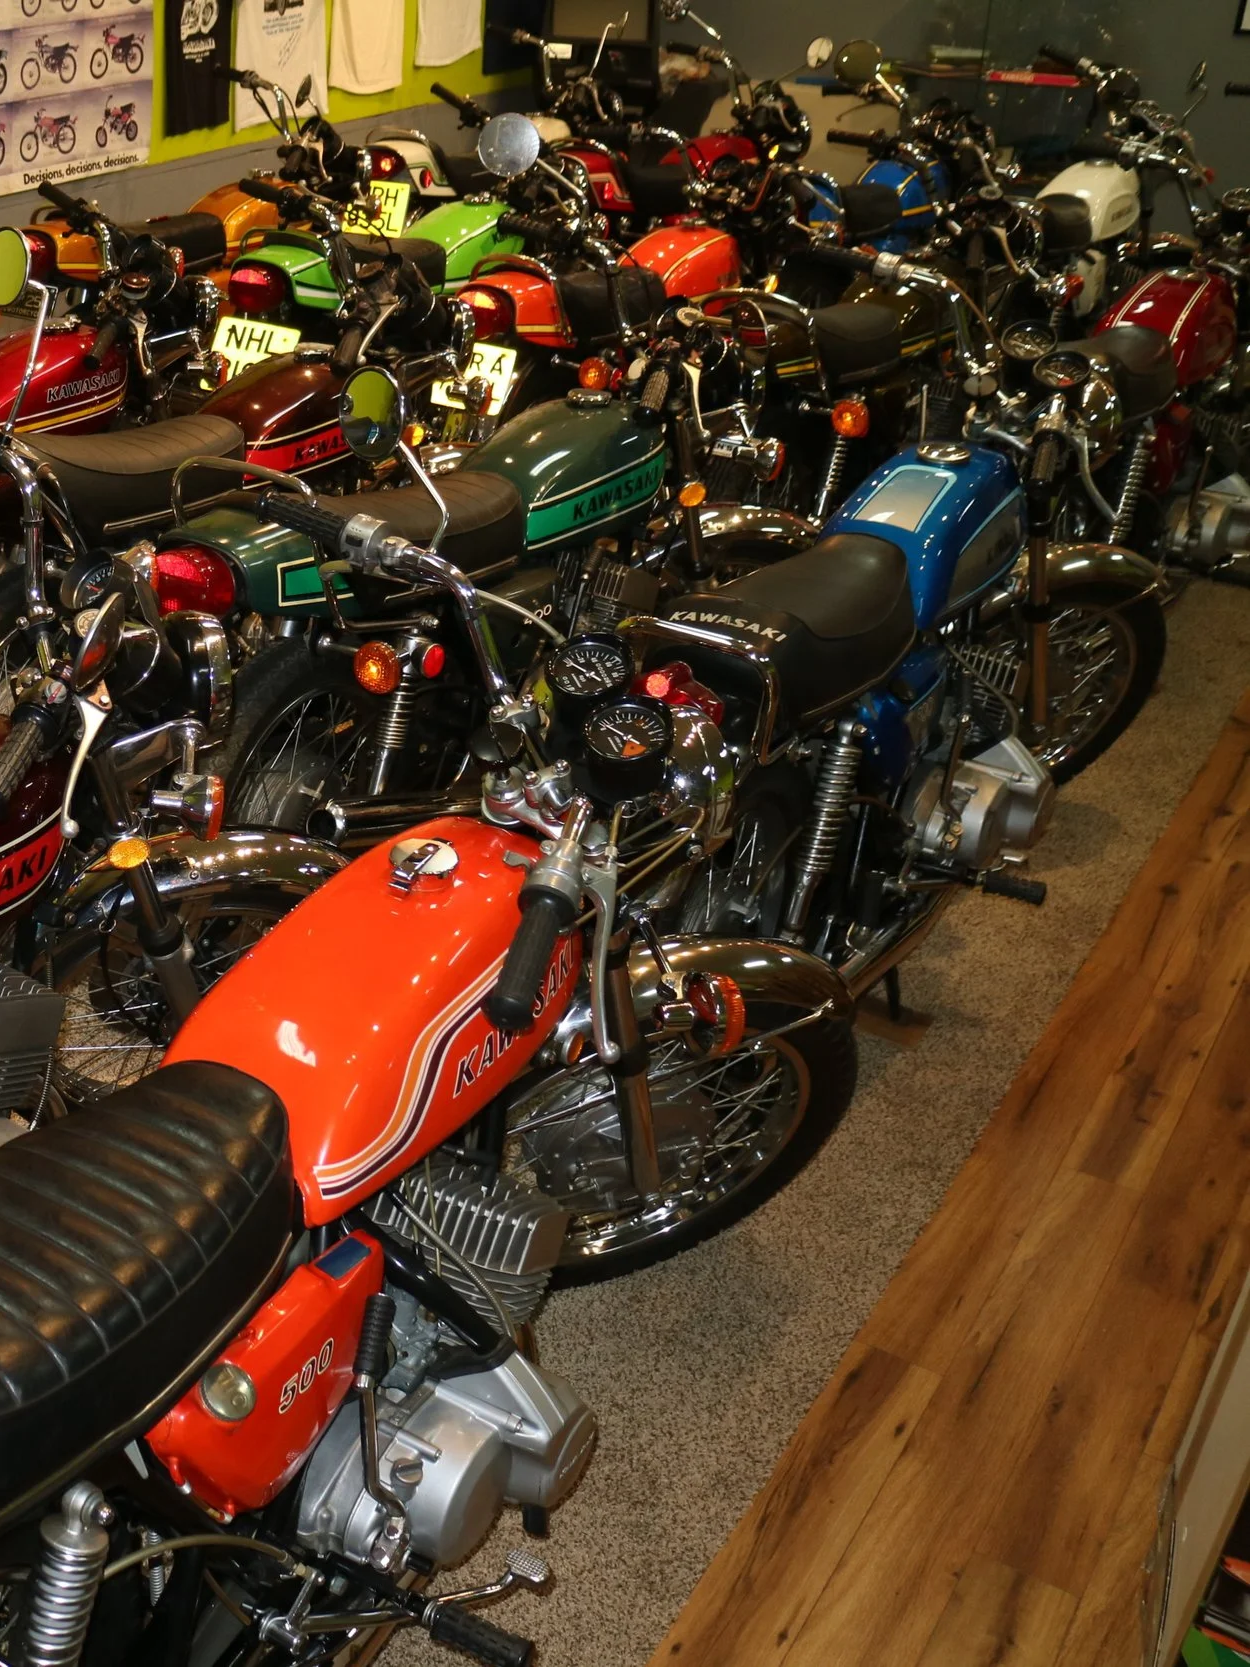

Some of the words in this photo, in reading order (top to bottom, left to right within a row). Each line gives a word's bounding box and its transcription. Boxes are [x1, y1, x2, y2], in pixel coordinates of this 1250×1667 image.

[23, 165, 65, 185] Decisions,
[65, 160, 103, 178] decisions,
[103, 153, 140, 170] decisions.
[46, 368, 121, 403] KAWASAKI
[573, 464, 660, 521] KAWASAKI
[668, 611, 788, 642] KAWASAKI
[278, 1337, 335, 1415] 500
